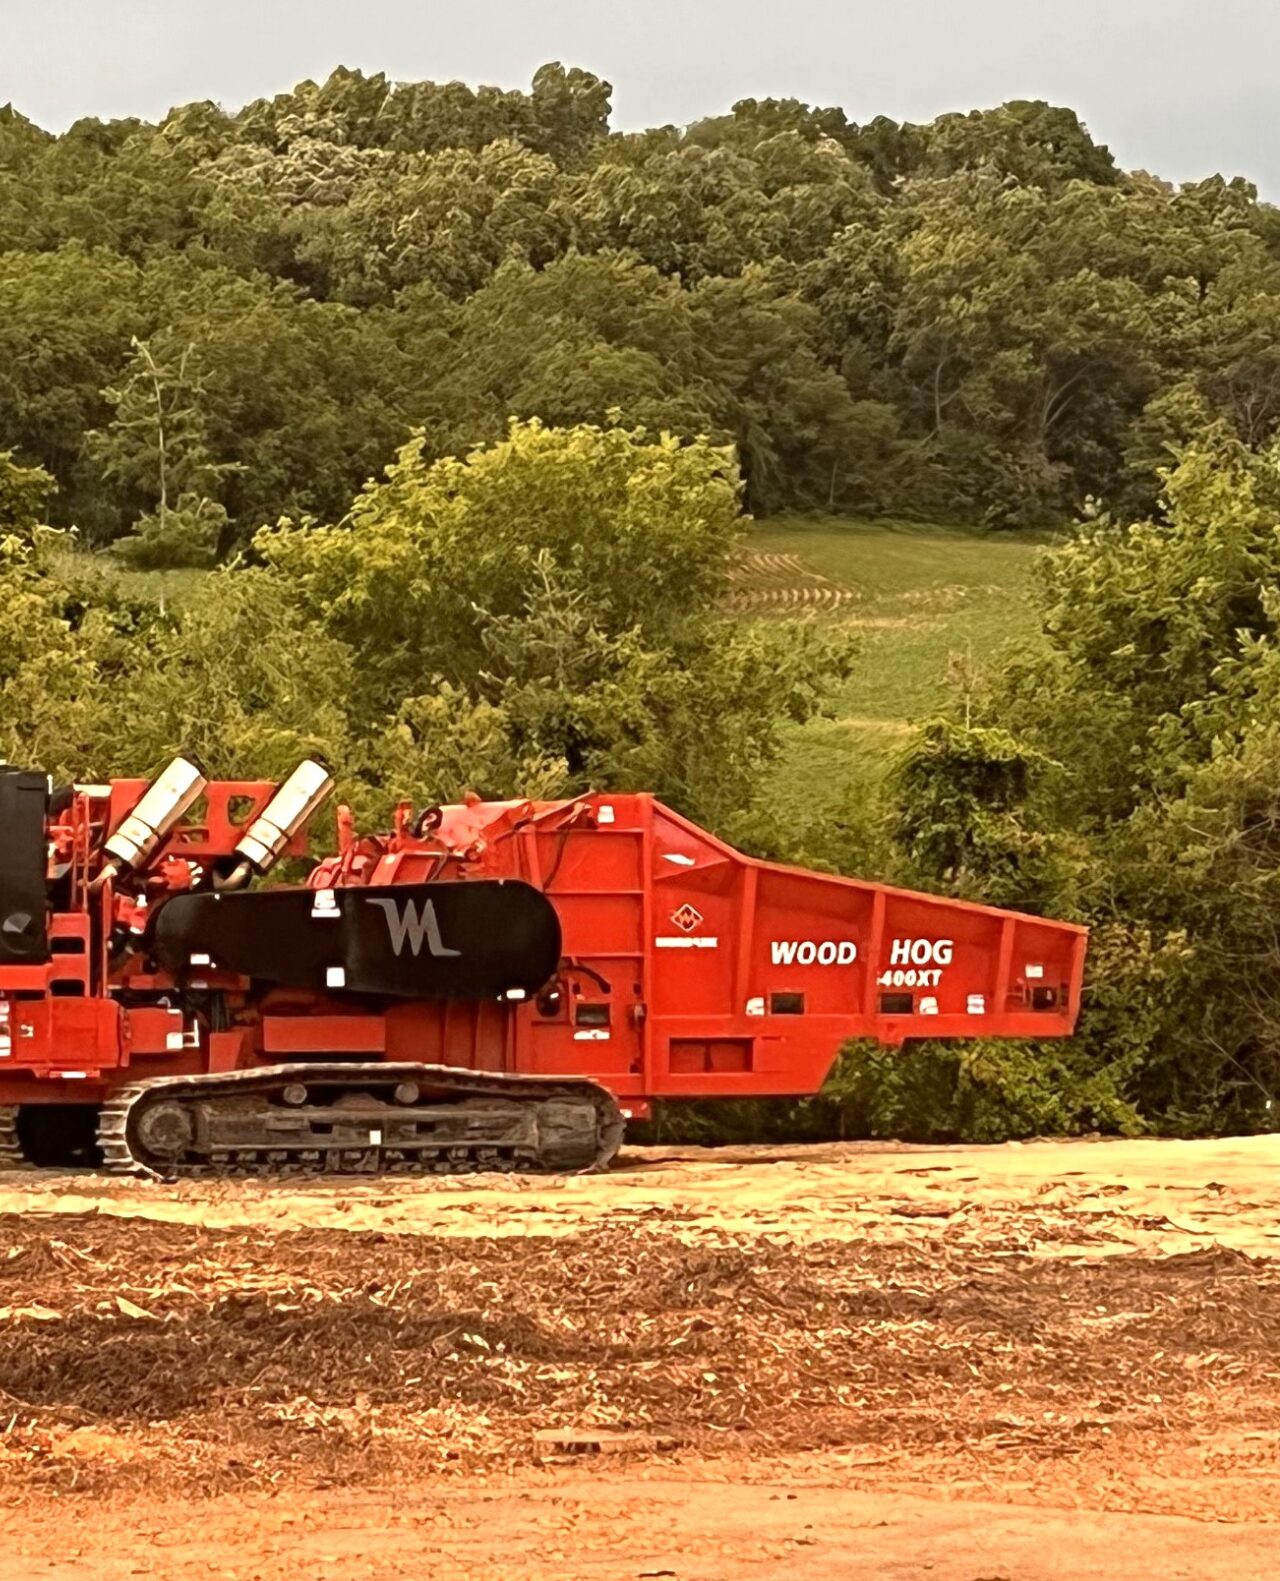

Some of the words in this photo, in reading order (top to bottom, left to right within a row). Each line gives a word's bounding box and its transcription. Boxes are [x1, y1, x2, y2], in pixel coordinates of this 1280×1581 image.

[770, 940, 857, 966] WOOD
[889, 938, 954, 966] HOG
[876, 968, 943, 988] 400XT
